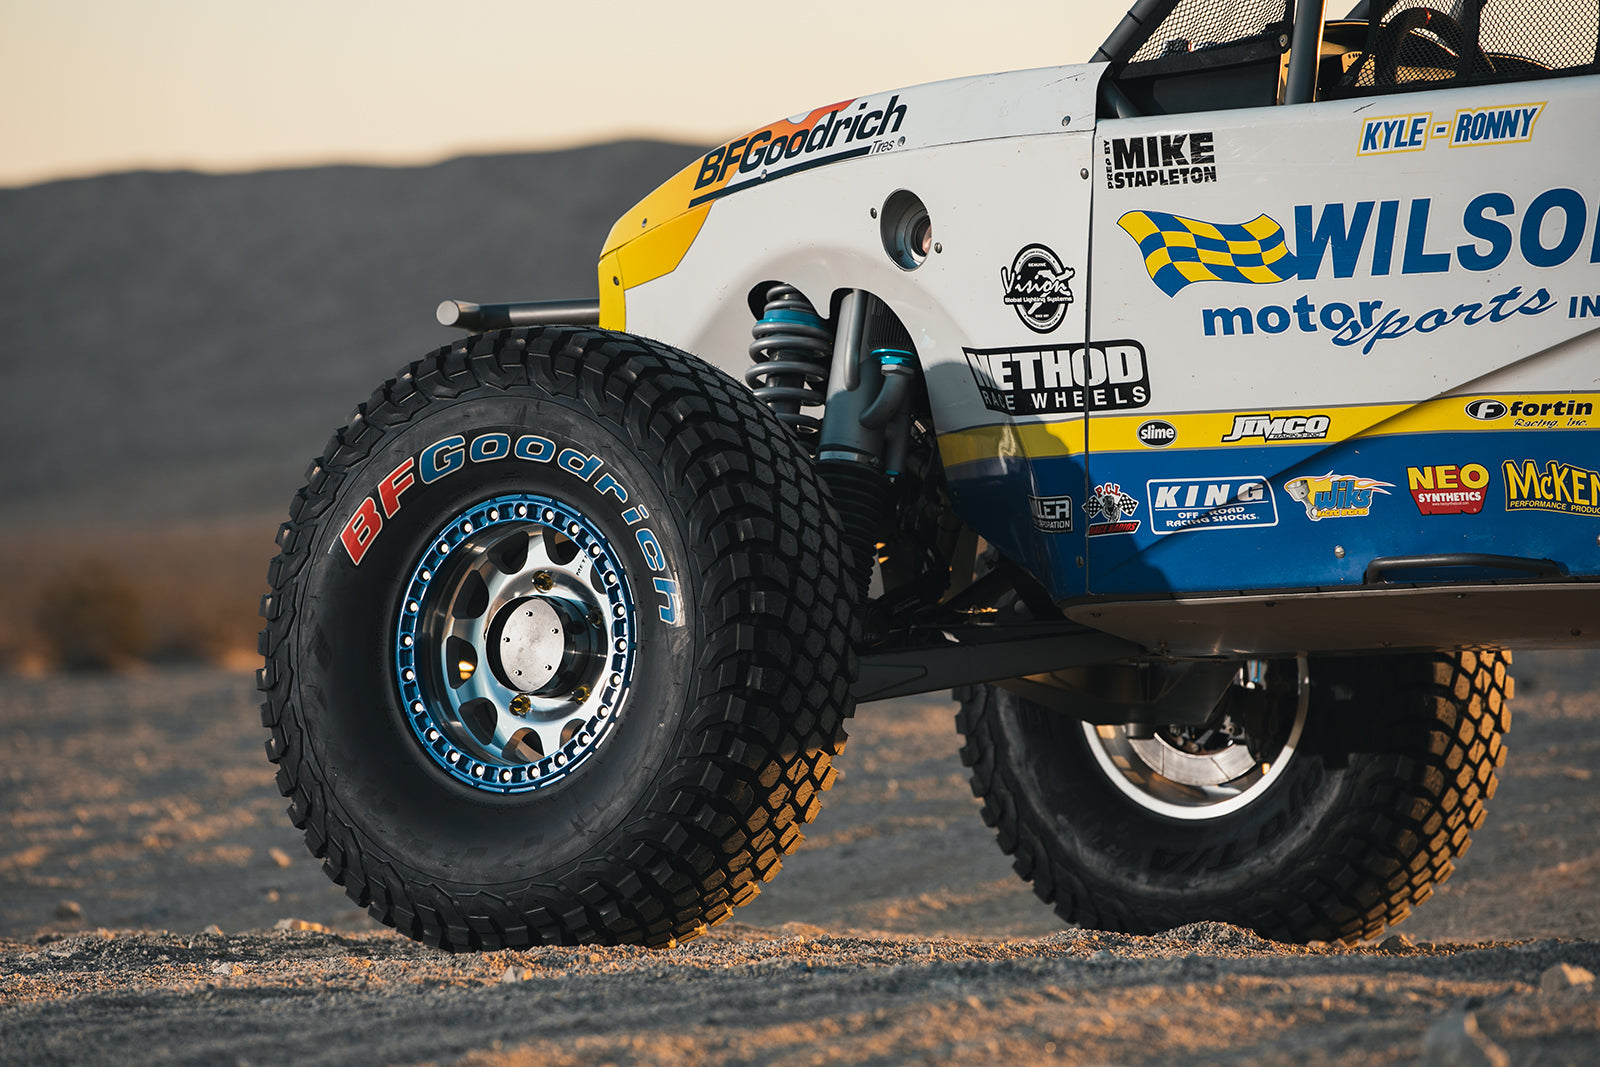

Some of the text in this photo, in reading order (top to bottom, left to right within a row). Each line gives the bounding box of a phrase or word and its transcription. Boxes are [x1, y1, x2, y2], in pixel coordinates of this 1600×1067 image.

[1362, 117, 1427, 150] KYLE
[1455, 108, 1537, 142] RONNY
[693, 95, 907, 190] BFGoodrich
[1112, 132, 1214, 170] MIKE
[1103, 140, 1114, 189] PREP BY
[1114, 166, 1217, 189] STAPLETON
[1295, 188, 1600, 280] WILSO
[1001, 267, 1067, 294] Vision
[1023, 296, 1046, 304] Lighting
[966, 345, 1144, 391] METHOD
[982, 386, 1147, 410] RACE WHEELS
[1510, 400, 1593, 416] fortin
[1140, 424, 1175, 440] slime
[1222, 414, 1330, 442] JIMCO
[1407, 463, 1490, 490] NEO
[1155, 482, 1264, 508] KING
[1314, 480, 1372, 509] wiks
[1418, 491, 1481, 503] SYNTHETICS
[1510, 500, 1567, 510] PERFORMANCE
[1166, 516, 1210, 528] RACING
[1177, 511, 1199, 519] OFF
[1209, 506, 1245, 516] ROAD
[340, 432, 681, 625] BFGoodrich
[1107, 522, 1137, 533] RADIOS
